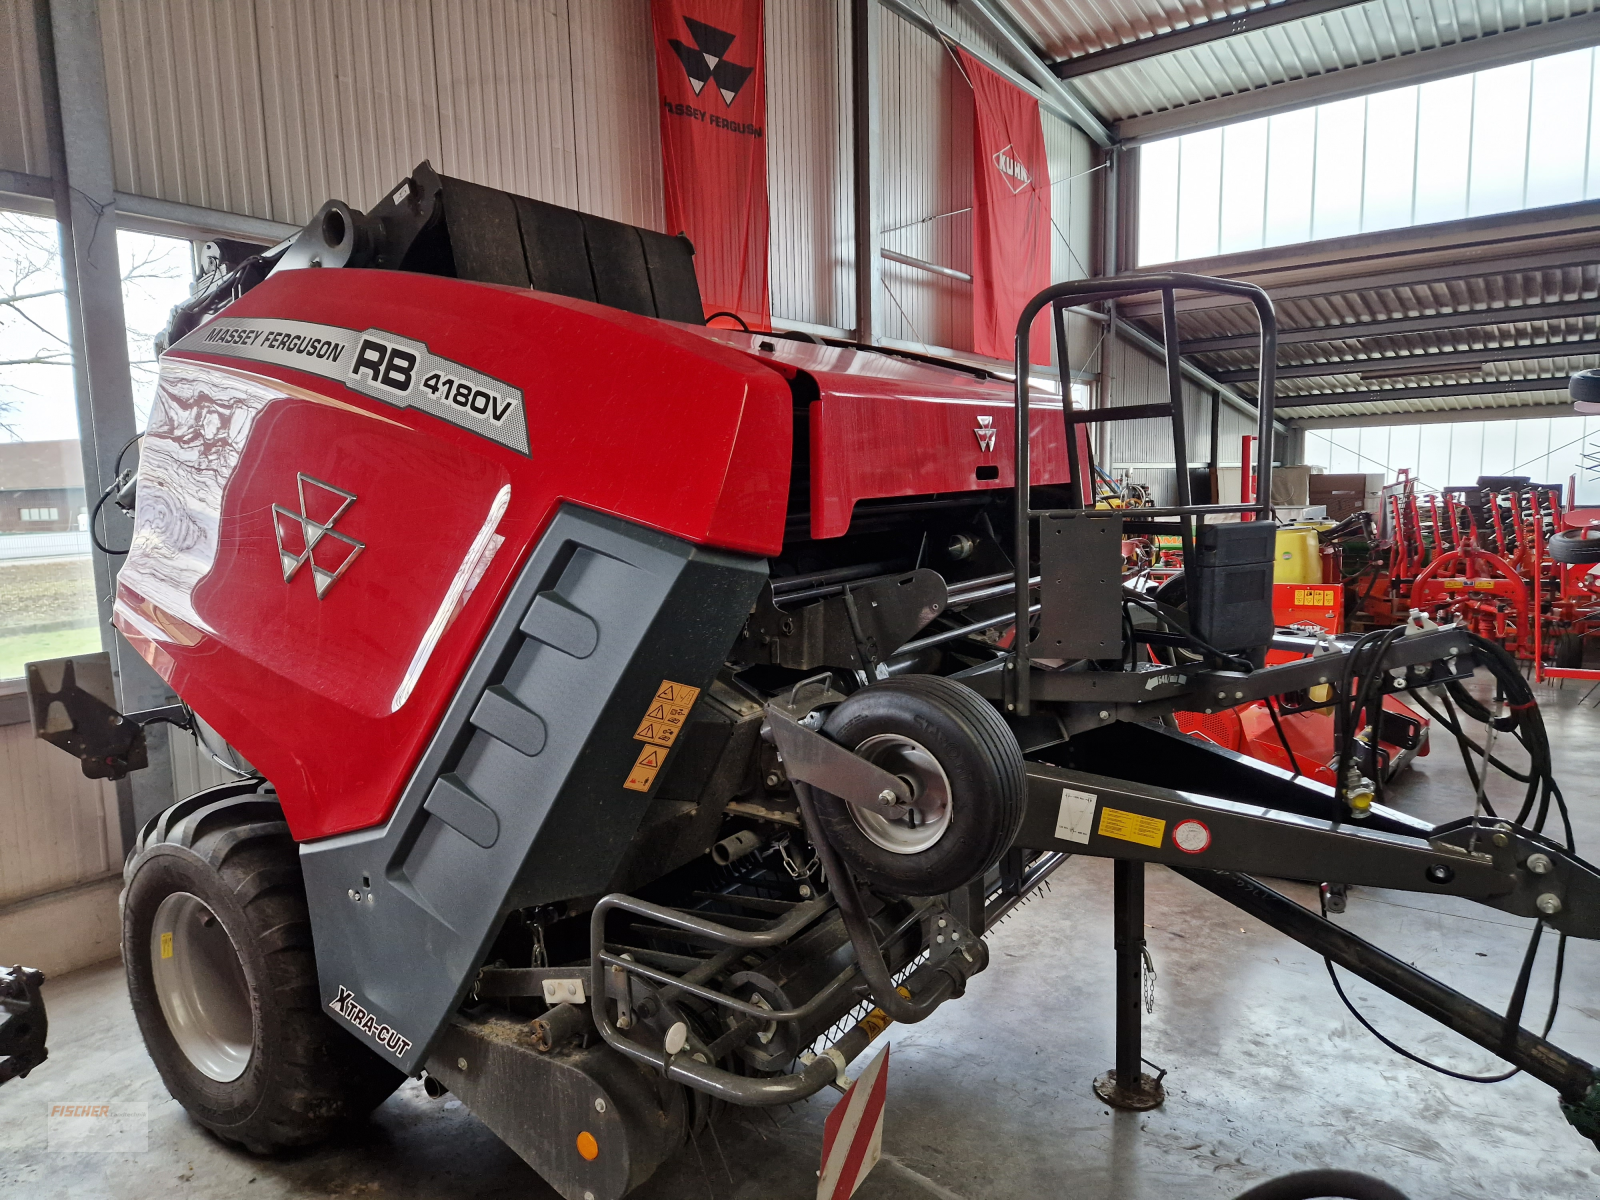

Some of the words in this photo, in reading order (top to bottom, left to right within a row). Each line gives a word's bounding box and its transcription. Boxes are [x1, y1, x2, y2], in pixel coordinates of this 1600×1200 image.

[998, 152, 1028, 183] KUHN
[204, 327, 264, 346] MASSEY
[260, 331, 345, 363] FERGUSON
[351, 338, 417, 392] RB
[422, 373, 512, 422] 4180V
[329, 984, 413, 1058] XTRA-CUT
